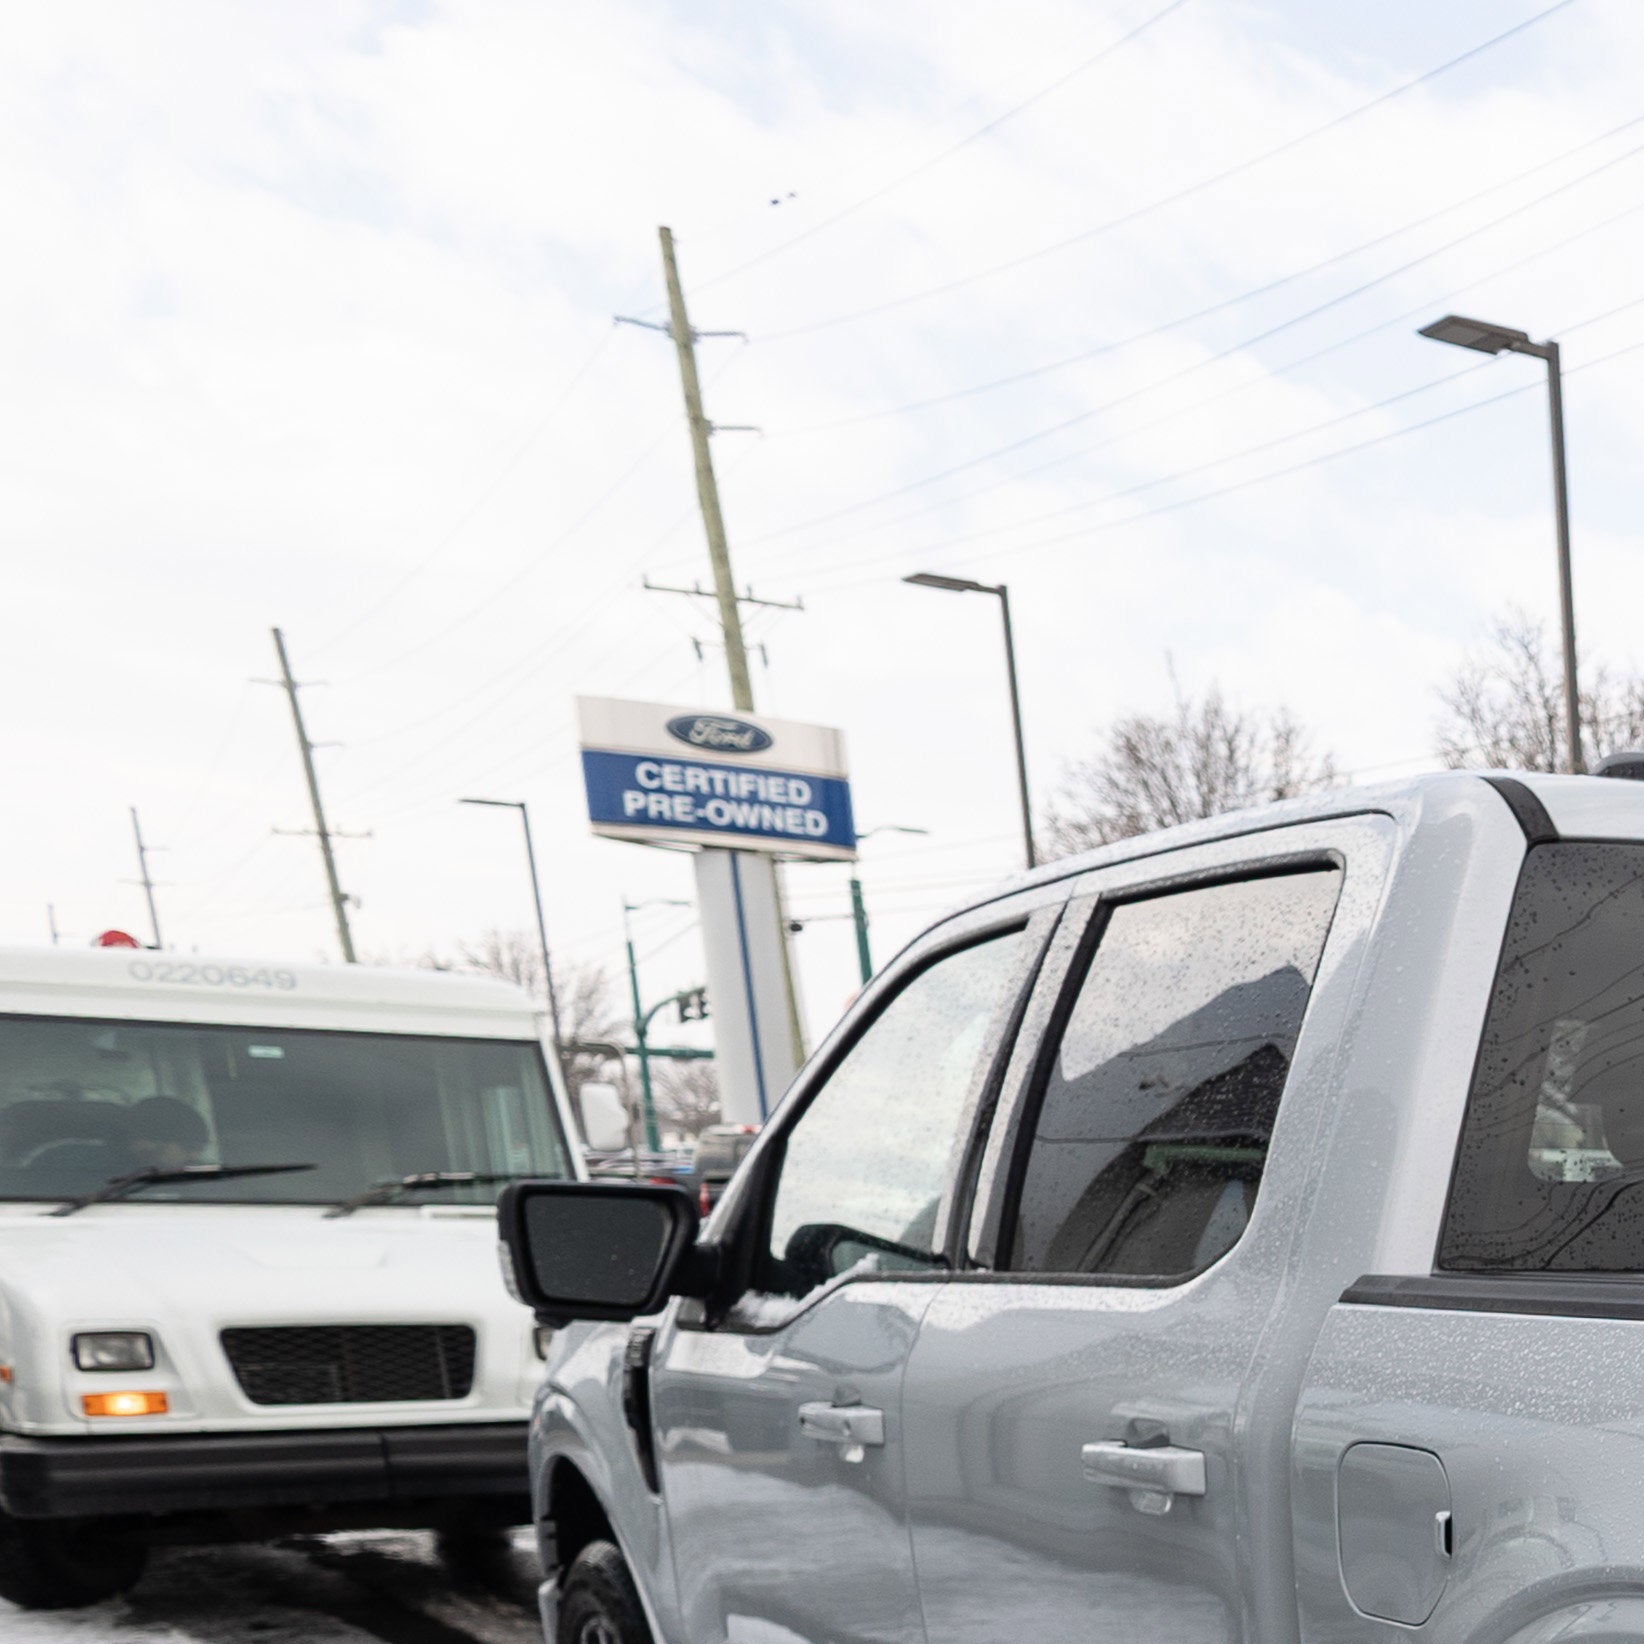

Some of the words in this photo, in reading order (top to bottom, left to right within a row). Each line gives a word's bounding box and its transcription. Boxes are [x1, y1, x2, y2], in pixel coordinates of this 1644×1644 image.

[689, 717, 755, 750] Ford
[634, 761, 812, 806] CERTIFIED
[622, 790, 829, 837] PRE-OWNED
[127, 960, 298, 991] 0220649
